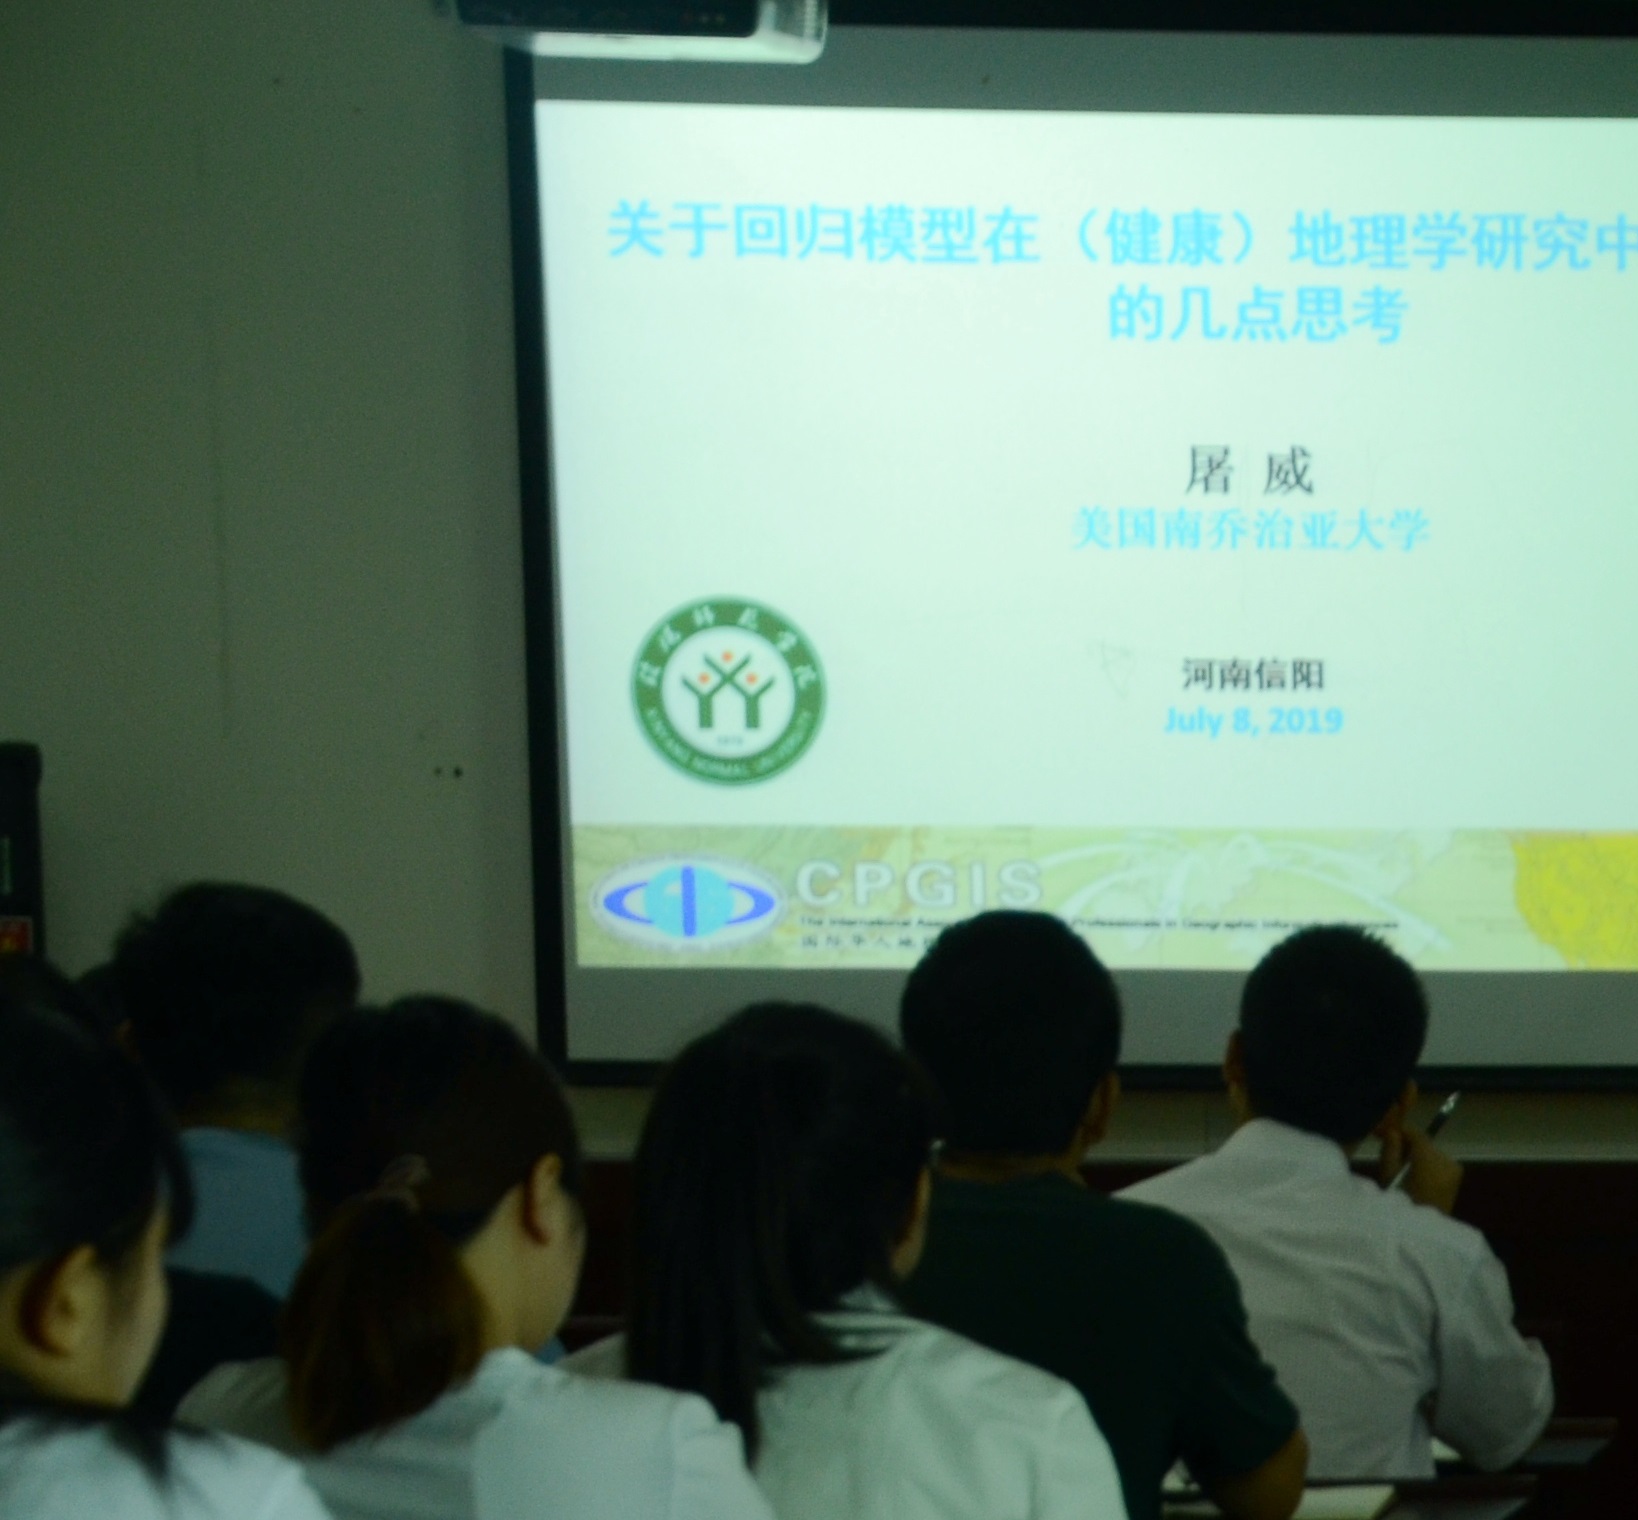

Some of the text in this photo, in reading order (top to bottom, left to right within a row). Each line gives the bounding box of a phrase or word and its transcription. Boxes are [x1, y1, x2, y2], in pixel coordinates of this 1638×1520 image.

[1108, 285, 1409, 347] 的几点思考
[1072, 507, 1431, 553] 美国南乔治亚大学
[1183, 656, 1326, 691] 河南信阳
[1164, 706, 1345, 740] July 8, 2019
[794, 858, 1046, 910] CPGIS
